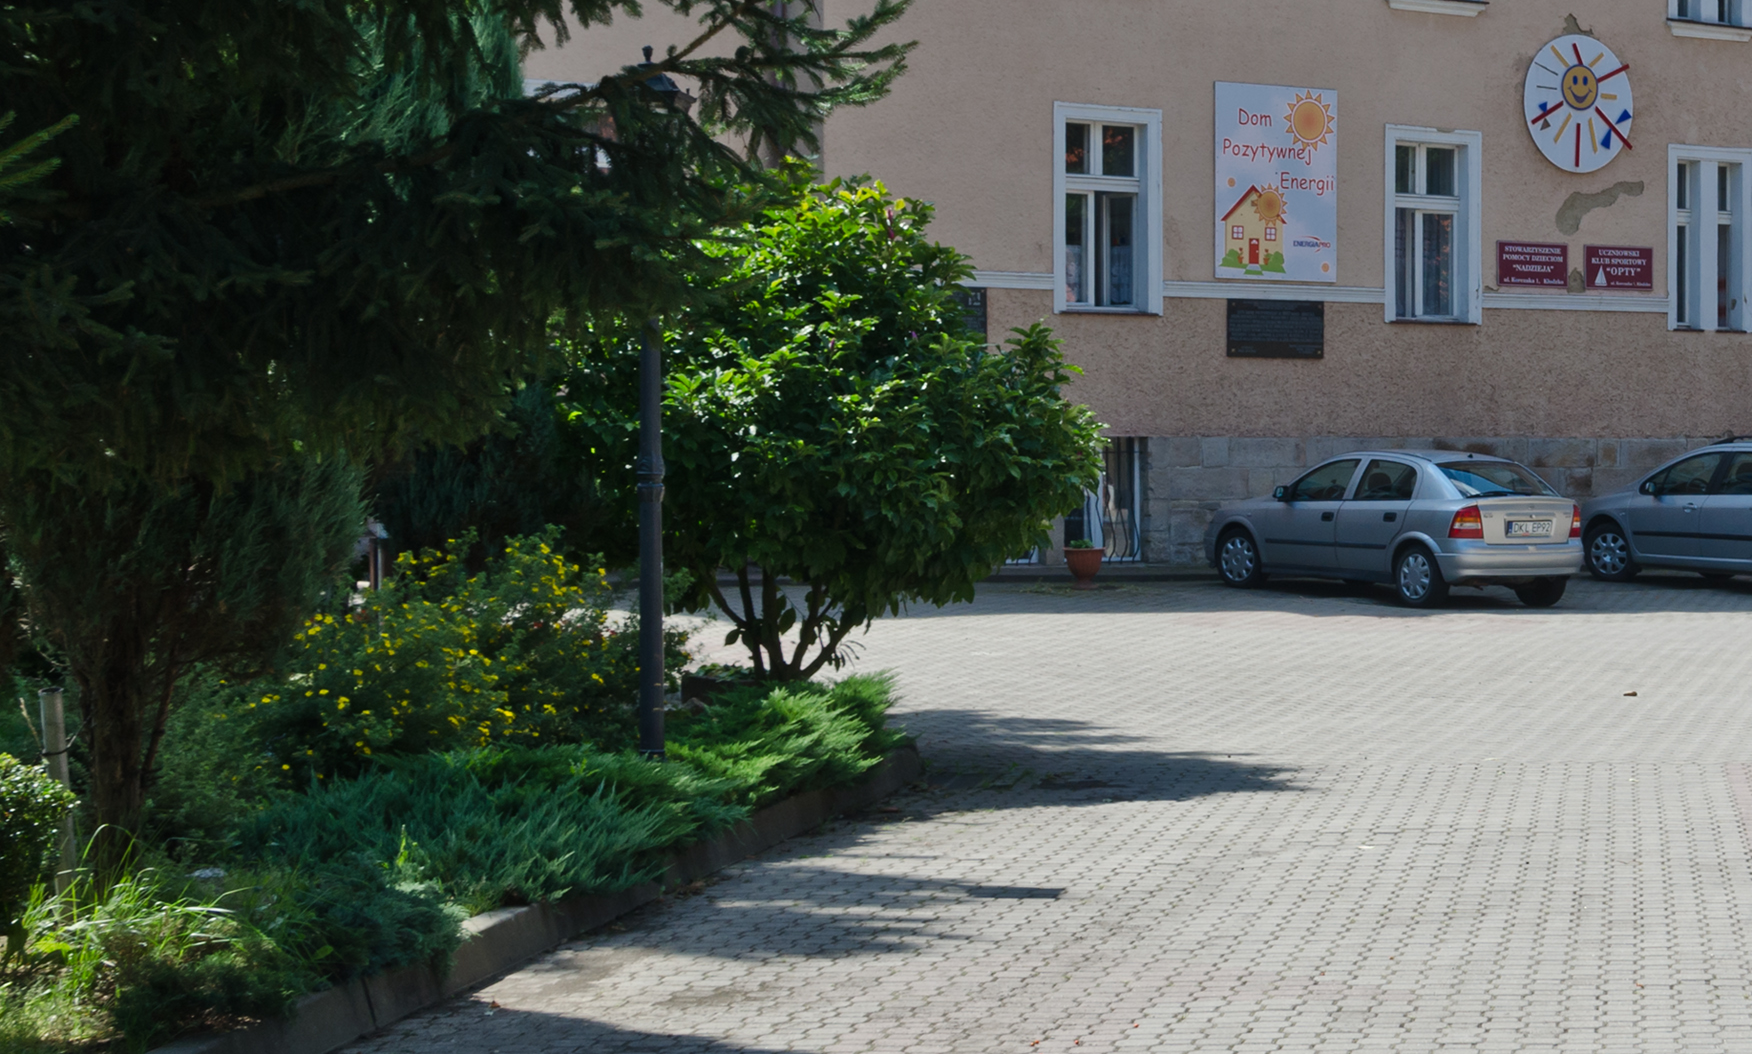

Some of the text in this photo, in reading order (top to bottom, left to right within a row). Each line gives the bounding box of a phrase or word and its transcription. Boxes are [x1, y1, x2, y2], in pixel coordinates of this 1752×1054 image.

[1238, 107, 1273, 127] Dom
[1222, 138, 1312, 166] Pozytywnej
[1280, 172, 1335, 196] Energii
[1502, 253, 1563, 263] POMOCY DZIECIOM
[1598, 249, 1640, 257] UCZNIOWSKI
[1611, 258, 1647, 266] SPORTOWY
[1513, 522, 1551, 533] DKL EP92
